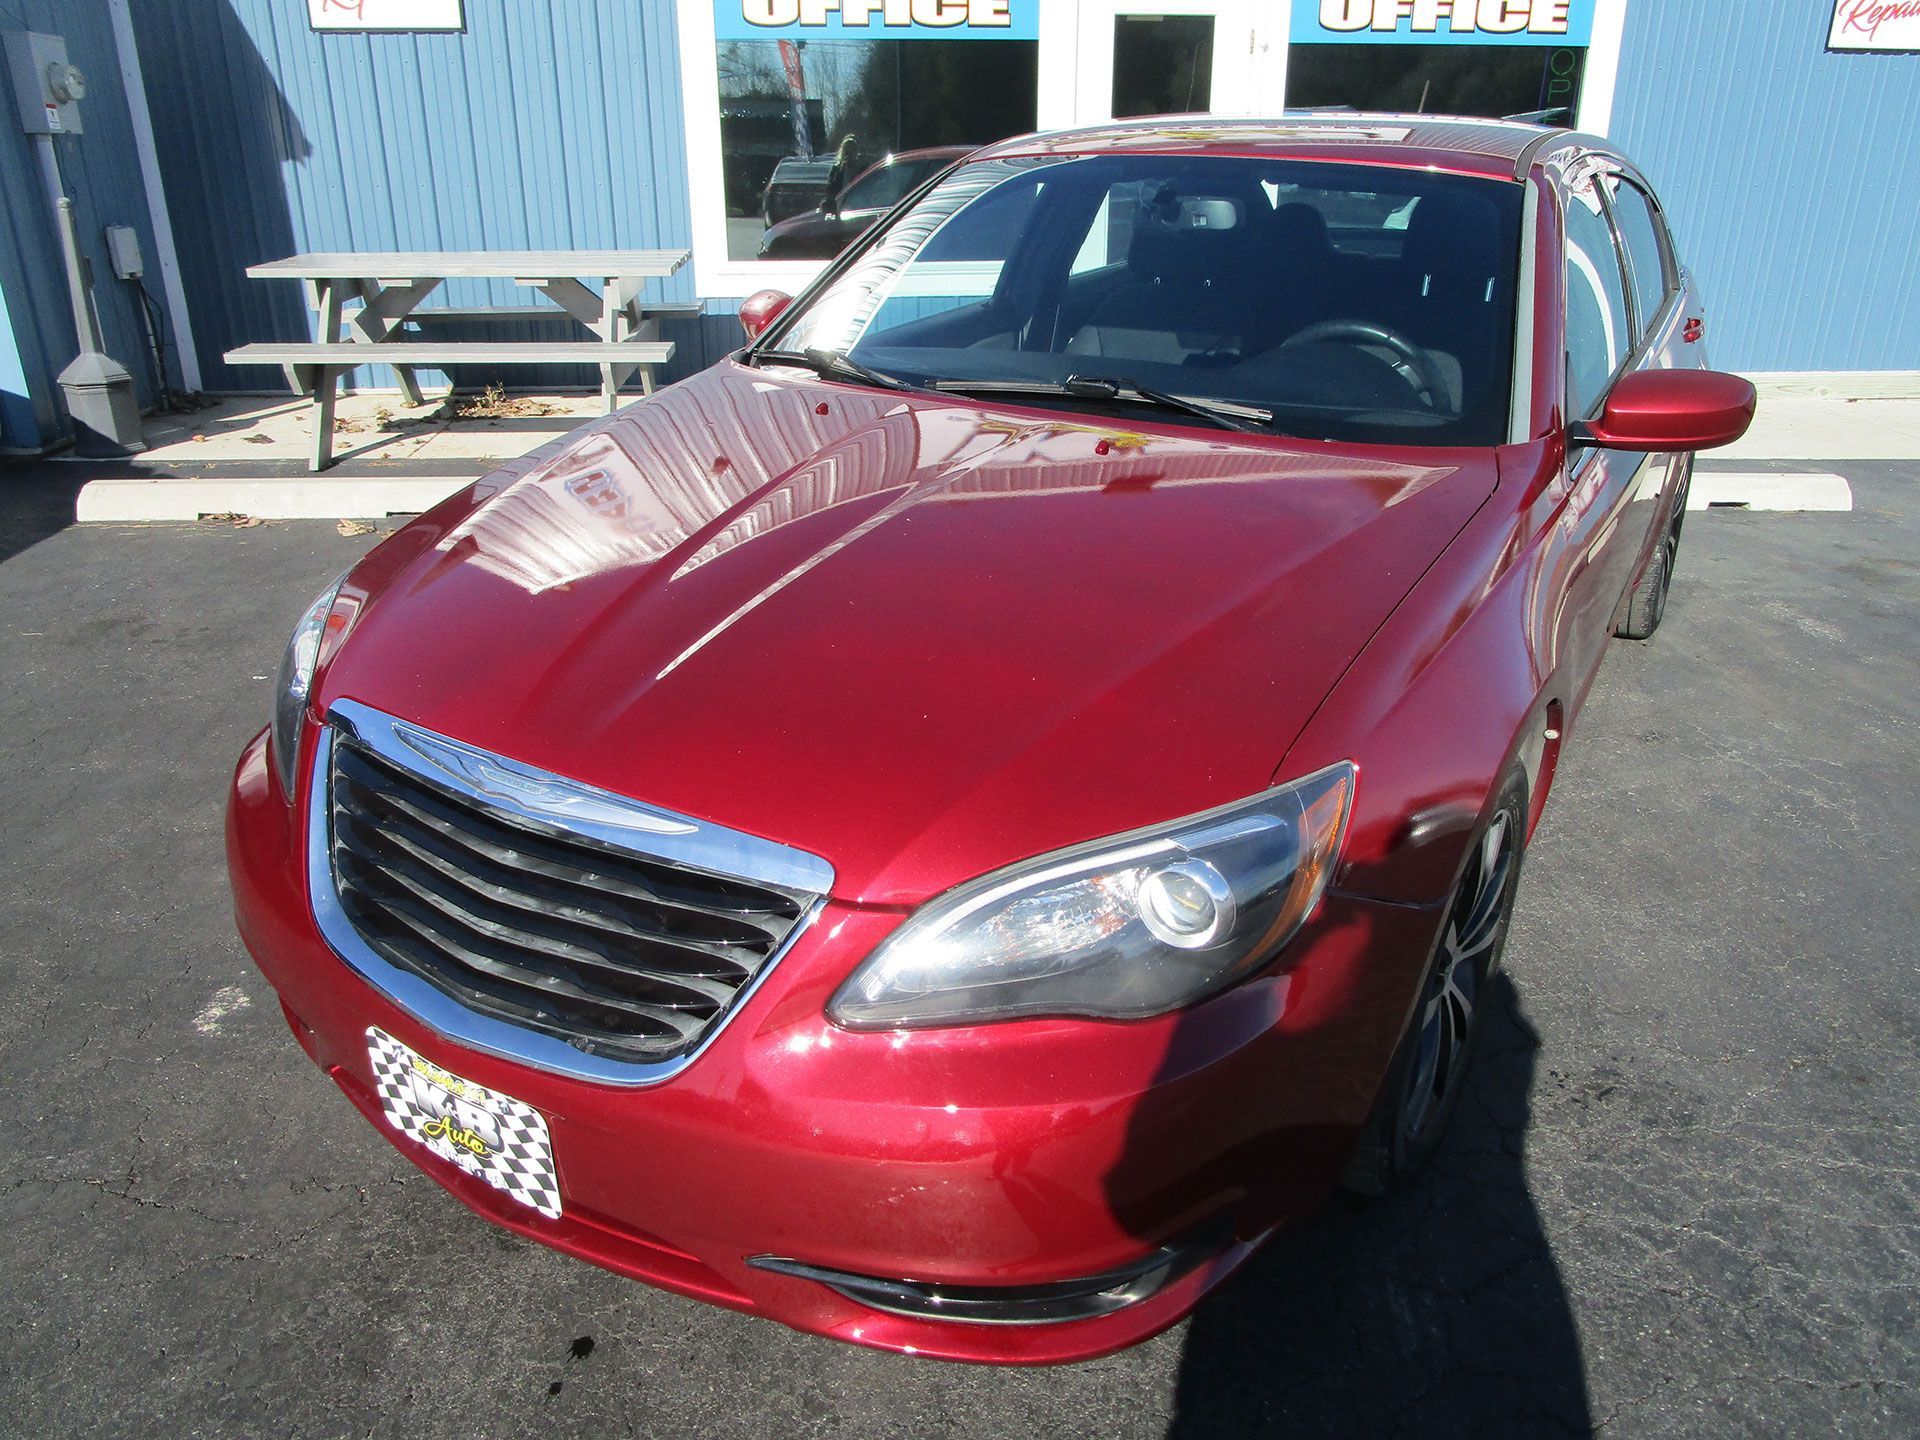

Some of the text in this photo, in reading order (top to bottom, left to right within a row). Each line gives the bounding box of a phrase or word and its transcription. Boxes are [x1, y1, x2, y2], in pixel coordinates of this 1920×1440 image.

[742, 0, 1011, 28] OFFICE
[1319, 0, 1568, 35] OFFICE
[1839, 0, 1920, 41] Repai
[424, 1116, 490, 1155] Auto
